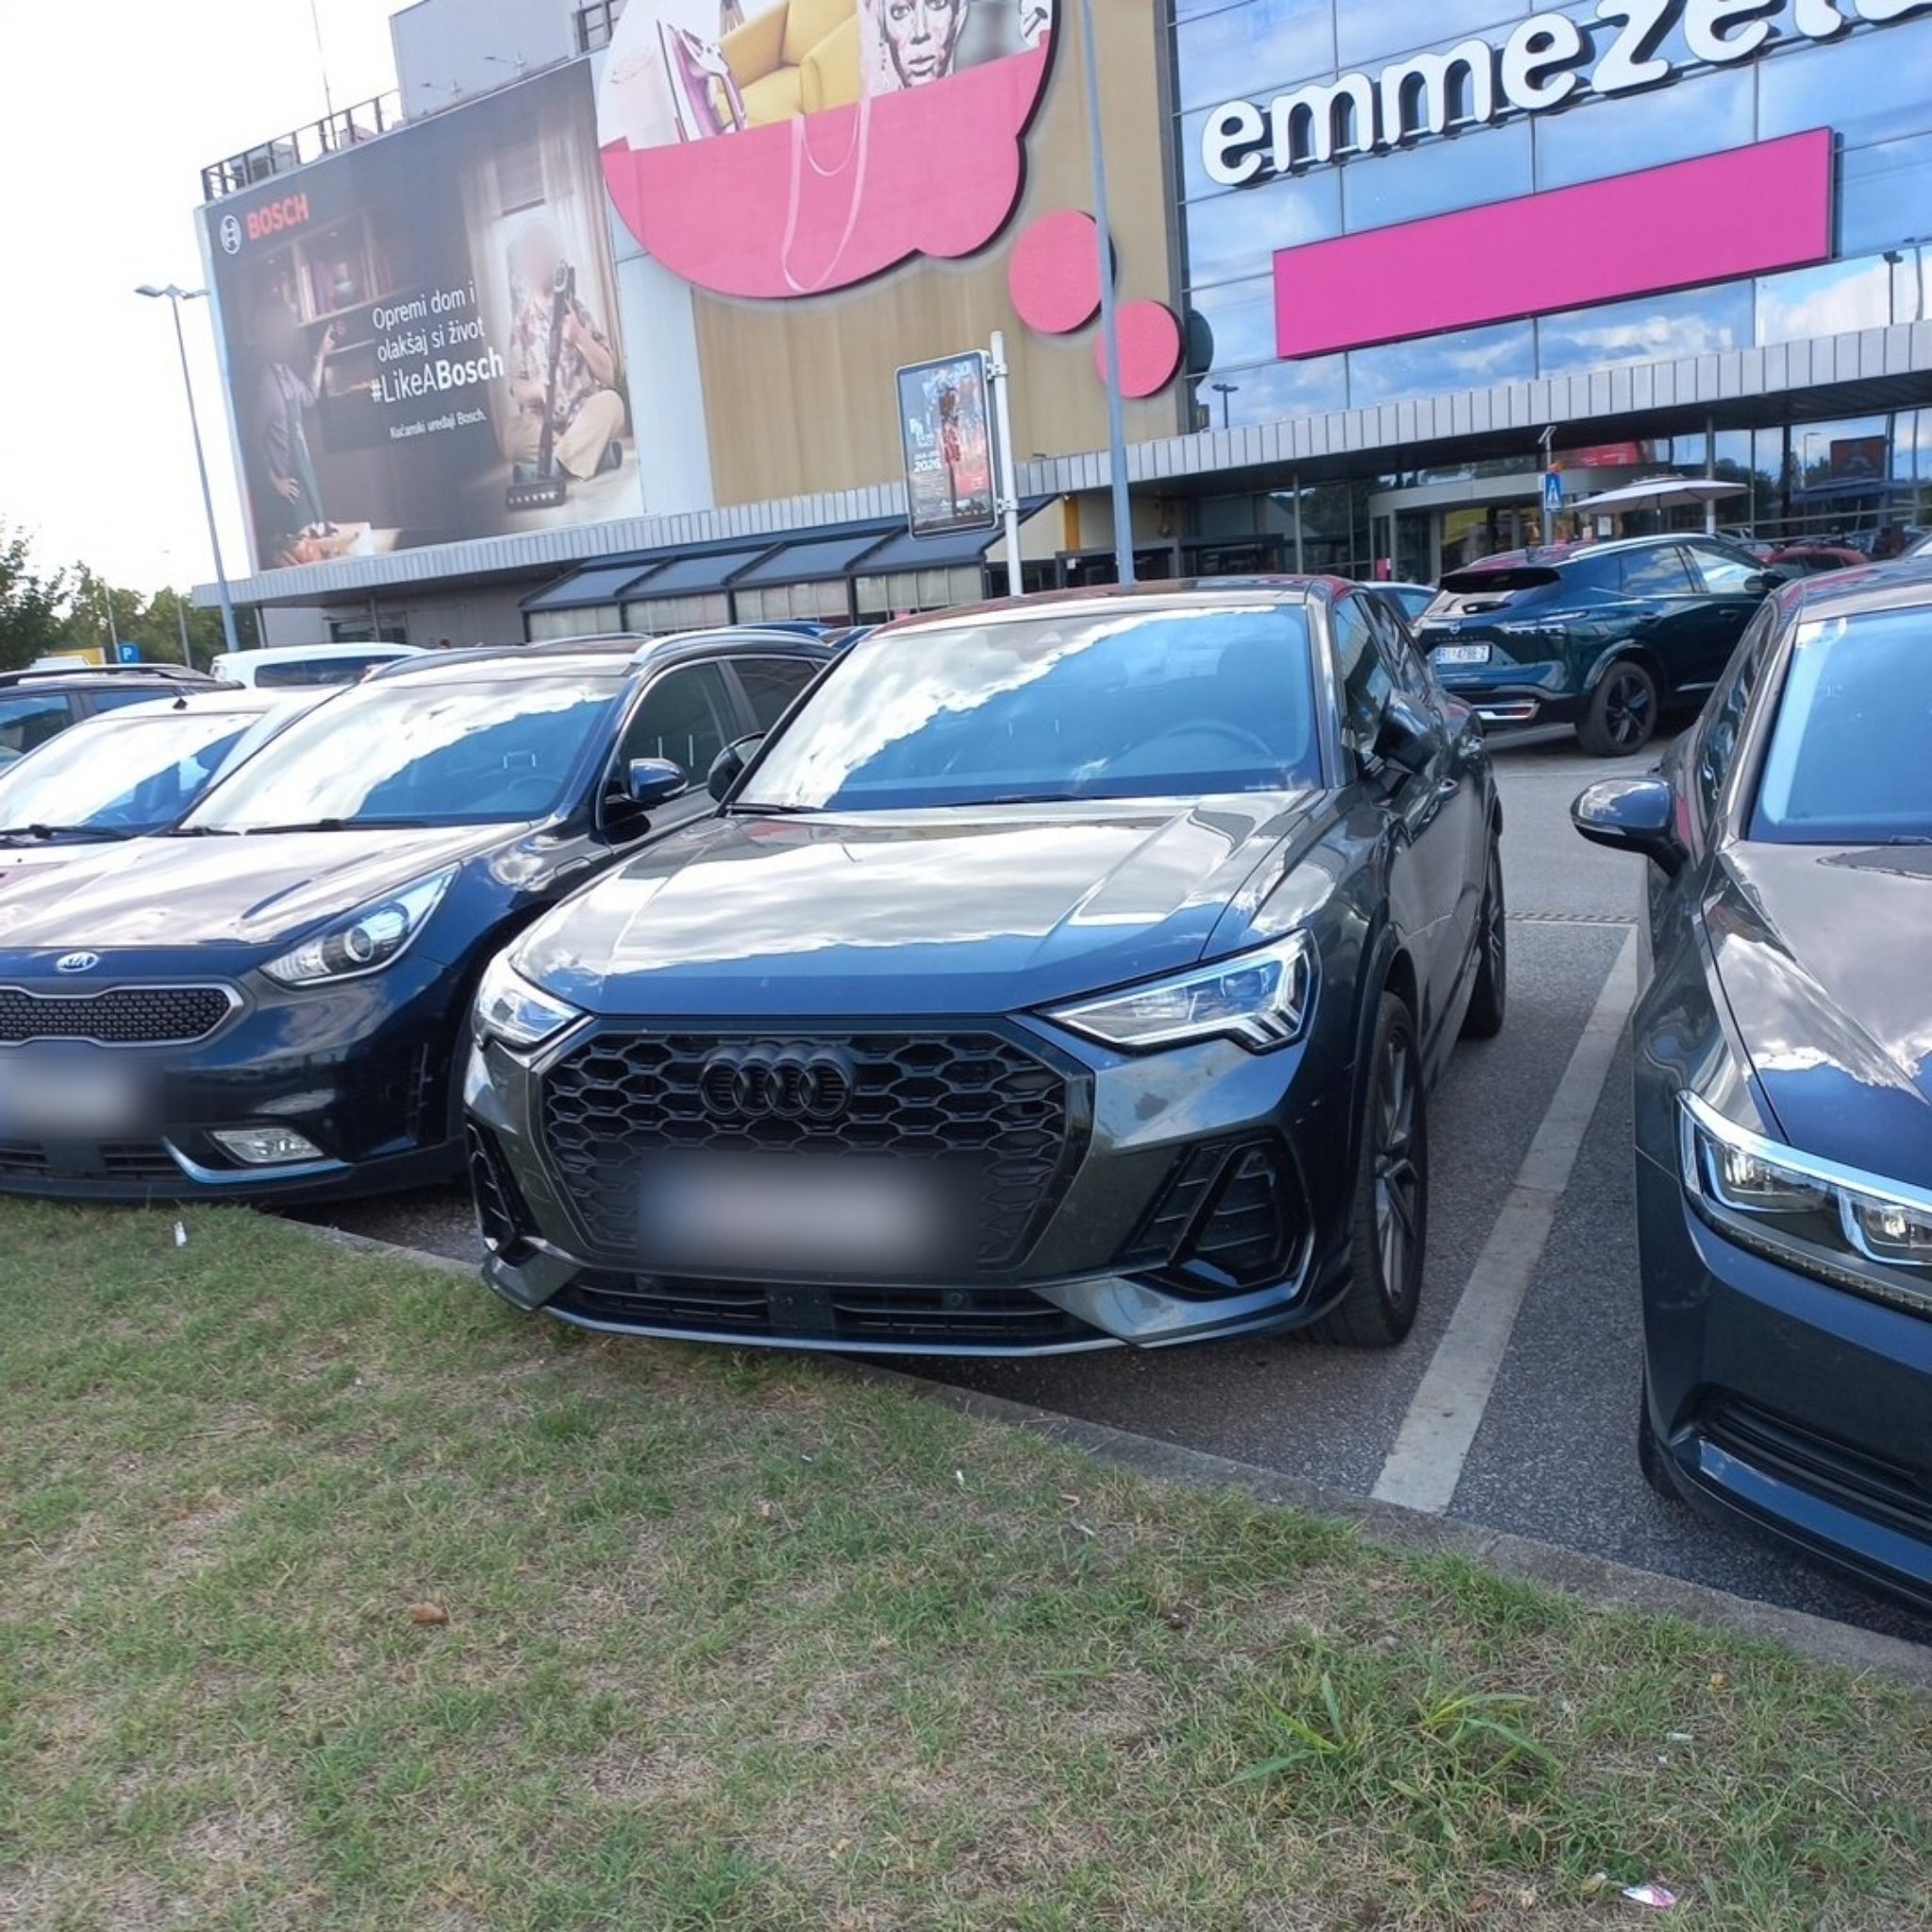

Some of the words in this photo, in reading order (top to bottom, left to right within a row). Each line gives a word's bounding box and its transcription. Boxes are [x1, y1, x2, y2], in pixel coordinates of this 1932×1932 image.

[1201, 0, 1928, 186] emmeze
[246, 192, 309, 240] BOSCH
[373, 293, 427, 331] Opremi
[430, 288, 466, 313] dom
[468, 280, 475, 303] i
[377, 328, 428, 362] olakšaj
[431, 324, 445, 348] si
[448, 316, 485, 344] život
[371, 346, 504, 403] #LikeABosch
[123, 647, 132, 660] P
